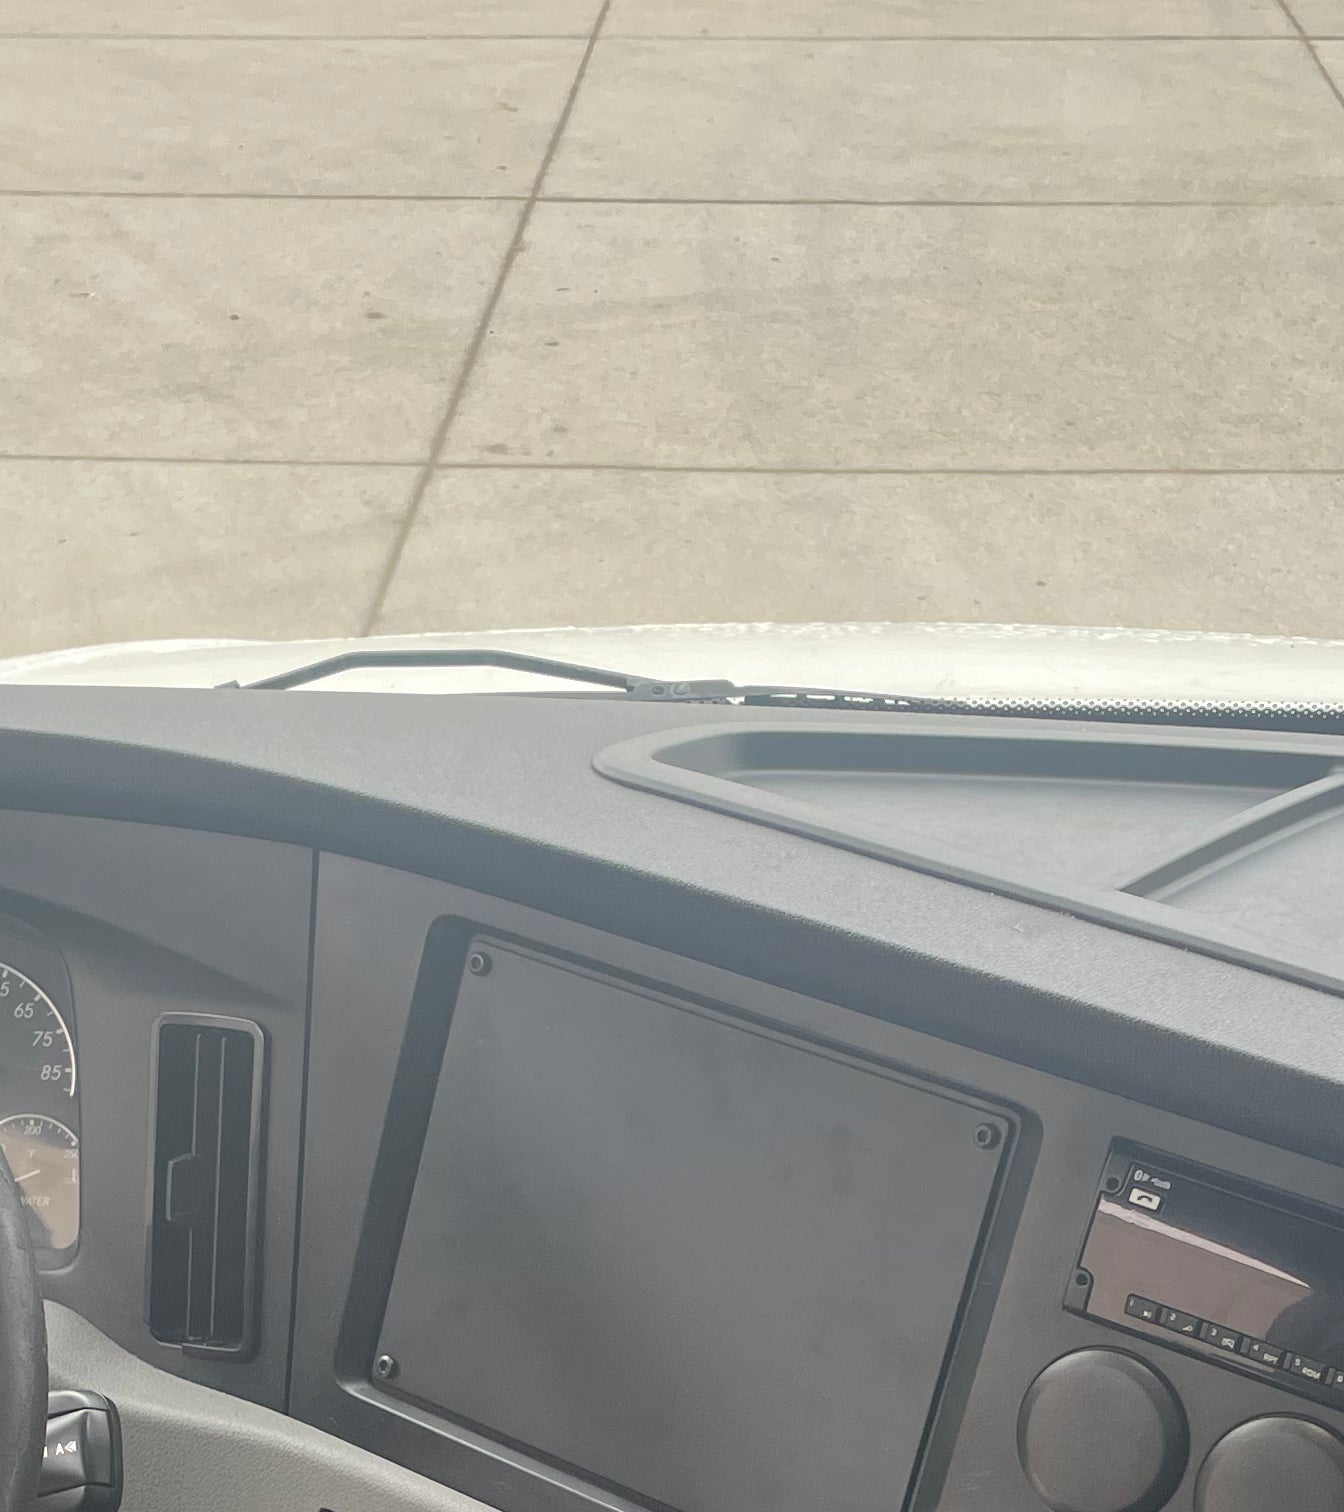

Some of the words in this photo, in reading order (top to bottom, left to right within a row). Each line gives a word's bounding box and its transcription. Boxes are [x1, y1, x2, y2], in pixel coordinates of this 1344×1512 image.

[14, 1003, 34, 1018] 65
[32, 1032, 53, 1047] 75
[40, 1065, 62, 1080] 85
[24, 1126, 42, 1136] 200
